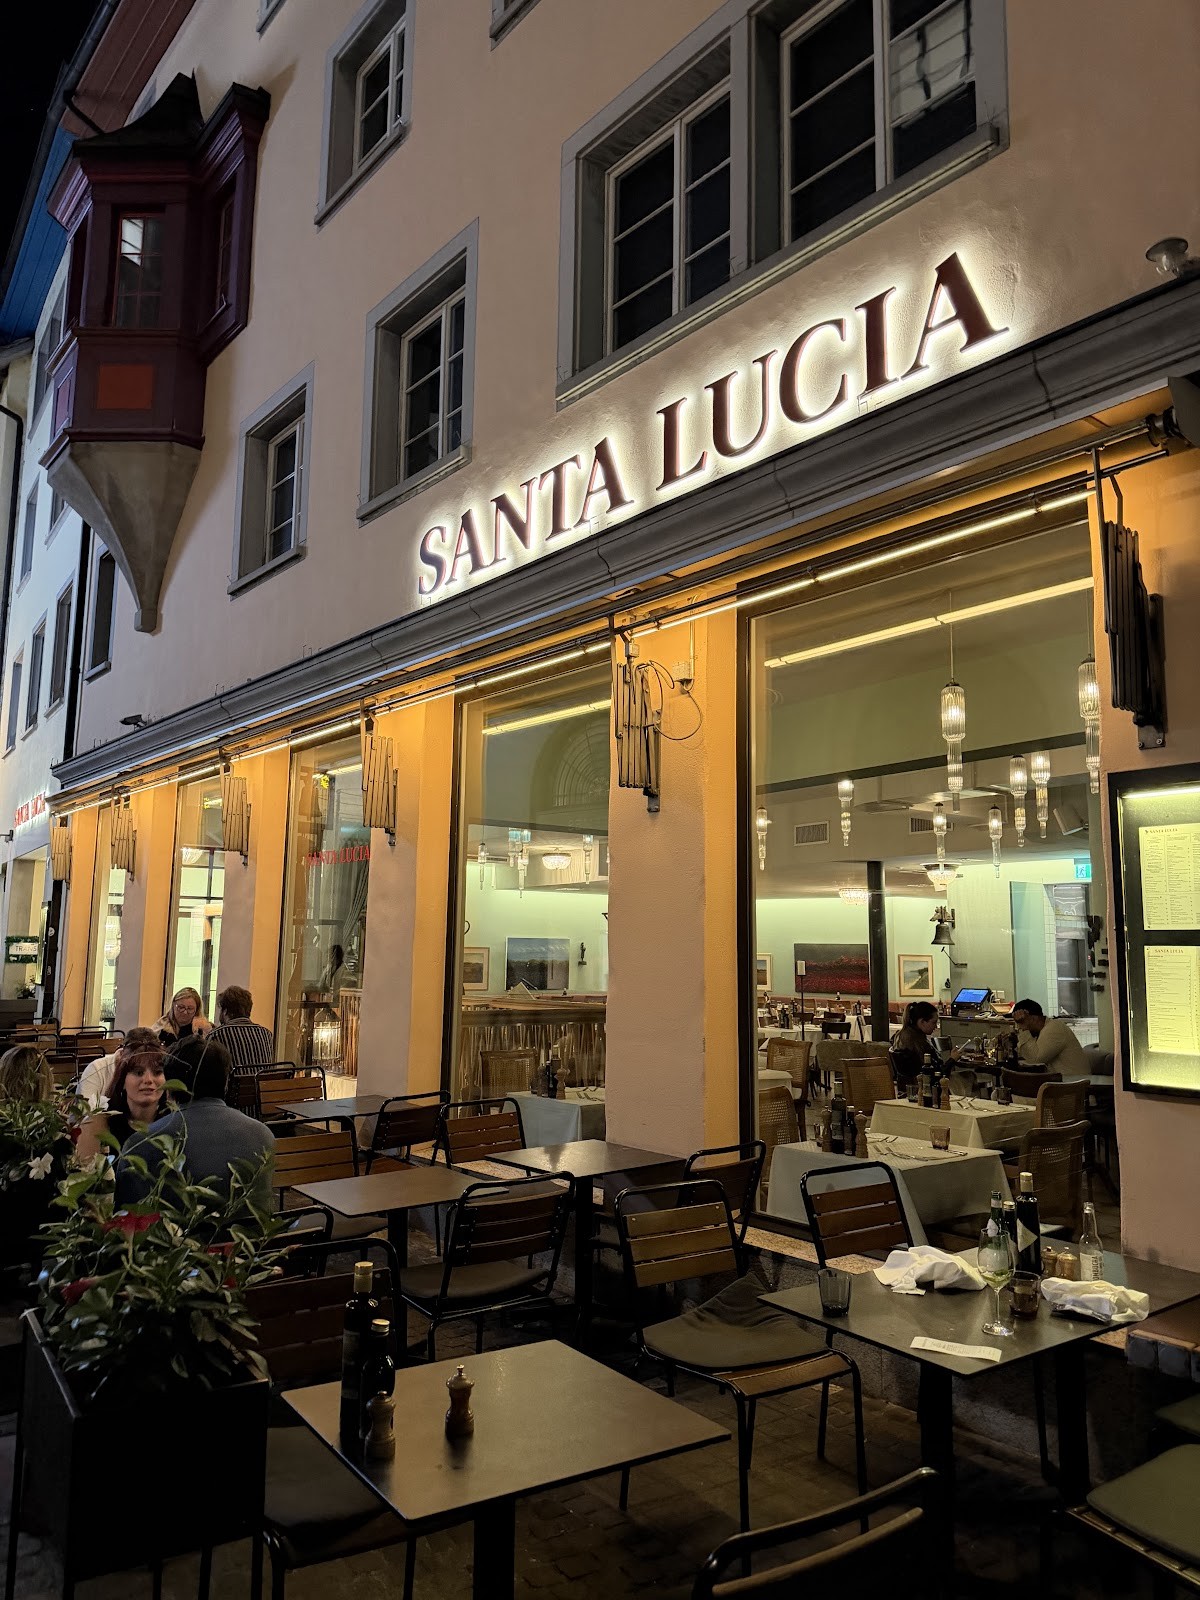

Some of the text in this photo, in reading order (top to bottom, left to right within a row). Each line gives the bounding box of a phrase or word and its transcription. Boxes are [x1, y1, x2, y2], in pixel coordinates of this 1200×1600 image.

[418, 251, 1010, 596] SANTA LUCIA
[339, 845, 371, 863] LUCIA
[1091, 1256, 1099, 1281] OMBUCHA
